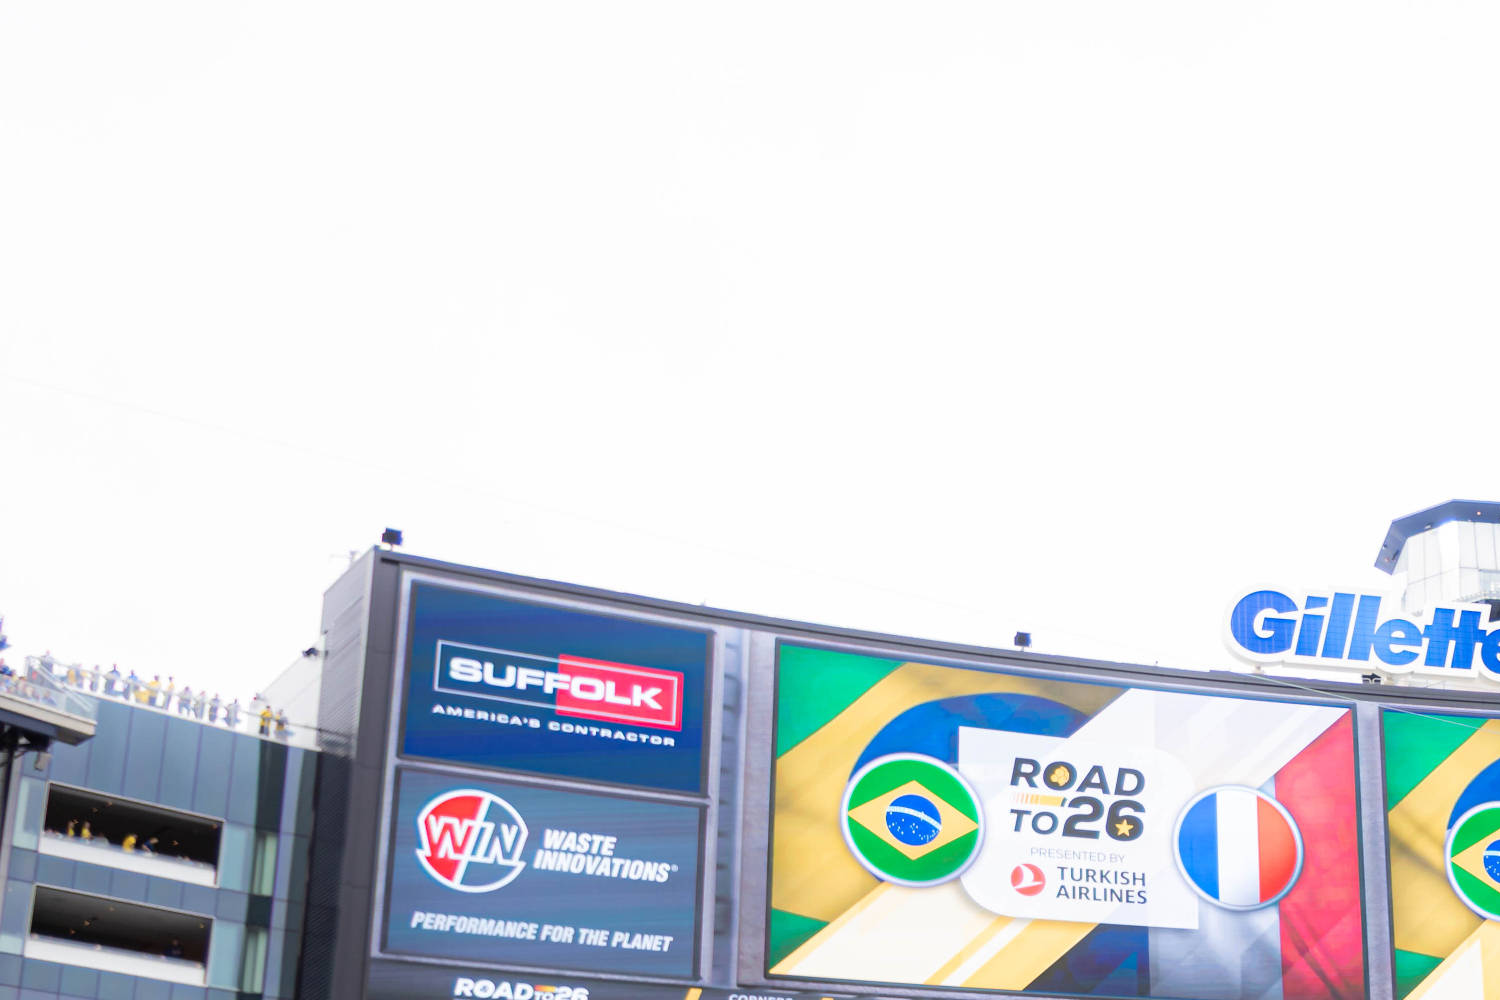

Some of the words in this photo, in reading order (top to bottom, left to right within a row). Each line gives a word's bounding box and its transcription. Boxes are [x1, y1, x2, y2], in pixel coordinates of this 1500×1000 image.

[449, 657, 663, 709] SUFFOLK
[432, 704, 540, 728] AMERICA'S
[548, 721, 675, 747] CONTRACTOR
[1010, 757, 1145, 796] ROAD
[1010, 808, 1059, 835] TO
[1062, 796, 1145, 842] 26
[428, 815, 518, 864] WIN
[544, 829, 616, 855] WASTE
[1030, 847, 1105, 862] PRESENTED
[1109, 852, 1125, 863] BY
[1056, 885, 1147, 904] AIRLINES
[1057, 866, 1146, 887] TURKISH
[411, 911, 537, 942] PERFORMANCE
[541, 922, 575, 945] FOR
[579, 925, 608, 948] THE
[611, 928, 673, 952] PLANET
[454, 978, 533, 1000] ROAD
